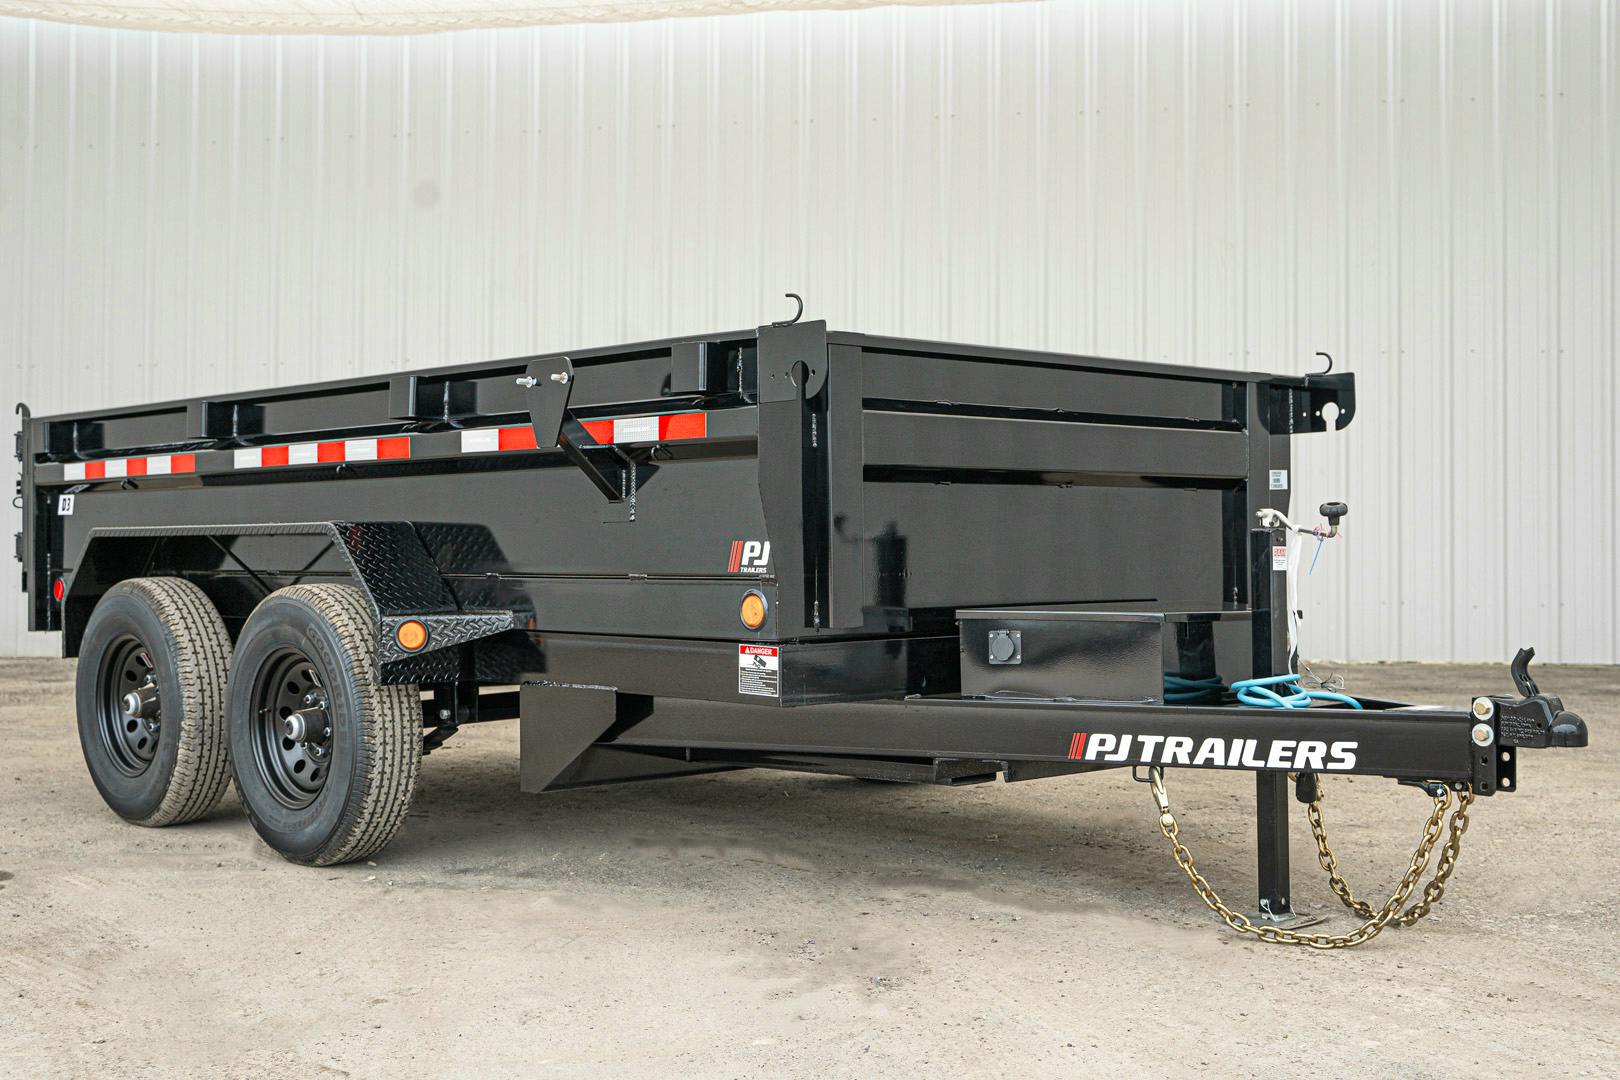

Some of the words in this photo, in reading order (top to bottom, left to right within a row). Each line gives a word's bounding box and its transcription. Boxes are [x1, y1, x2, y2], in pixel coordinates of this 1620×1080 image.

[62, 498, 71, 511] D3
[741, 541, 770, 566] PJ
[750, 647, 773, 656] DANGER
[1084, 733, 1133, 762] PJ
[1135, 735, 1359, 770] TRAILERS
